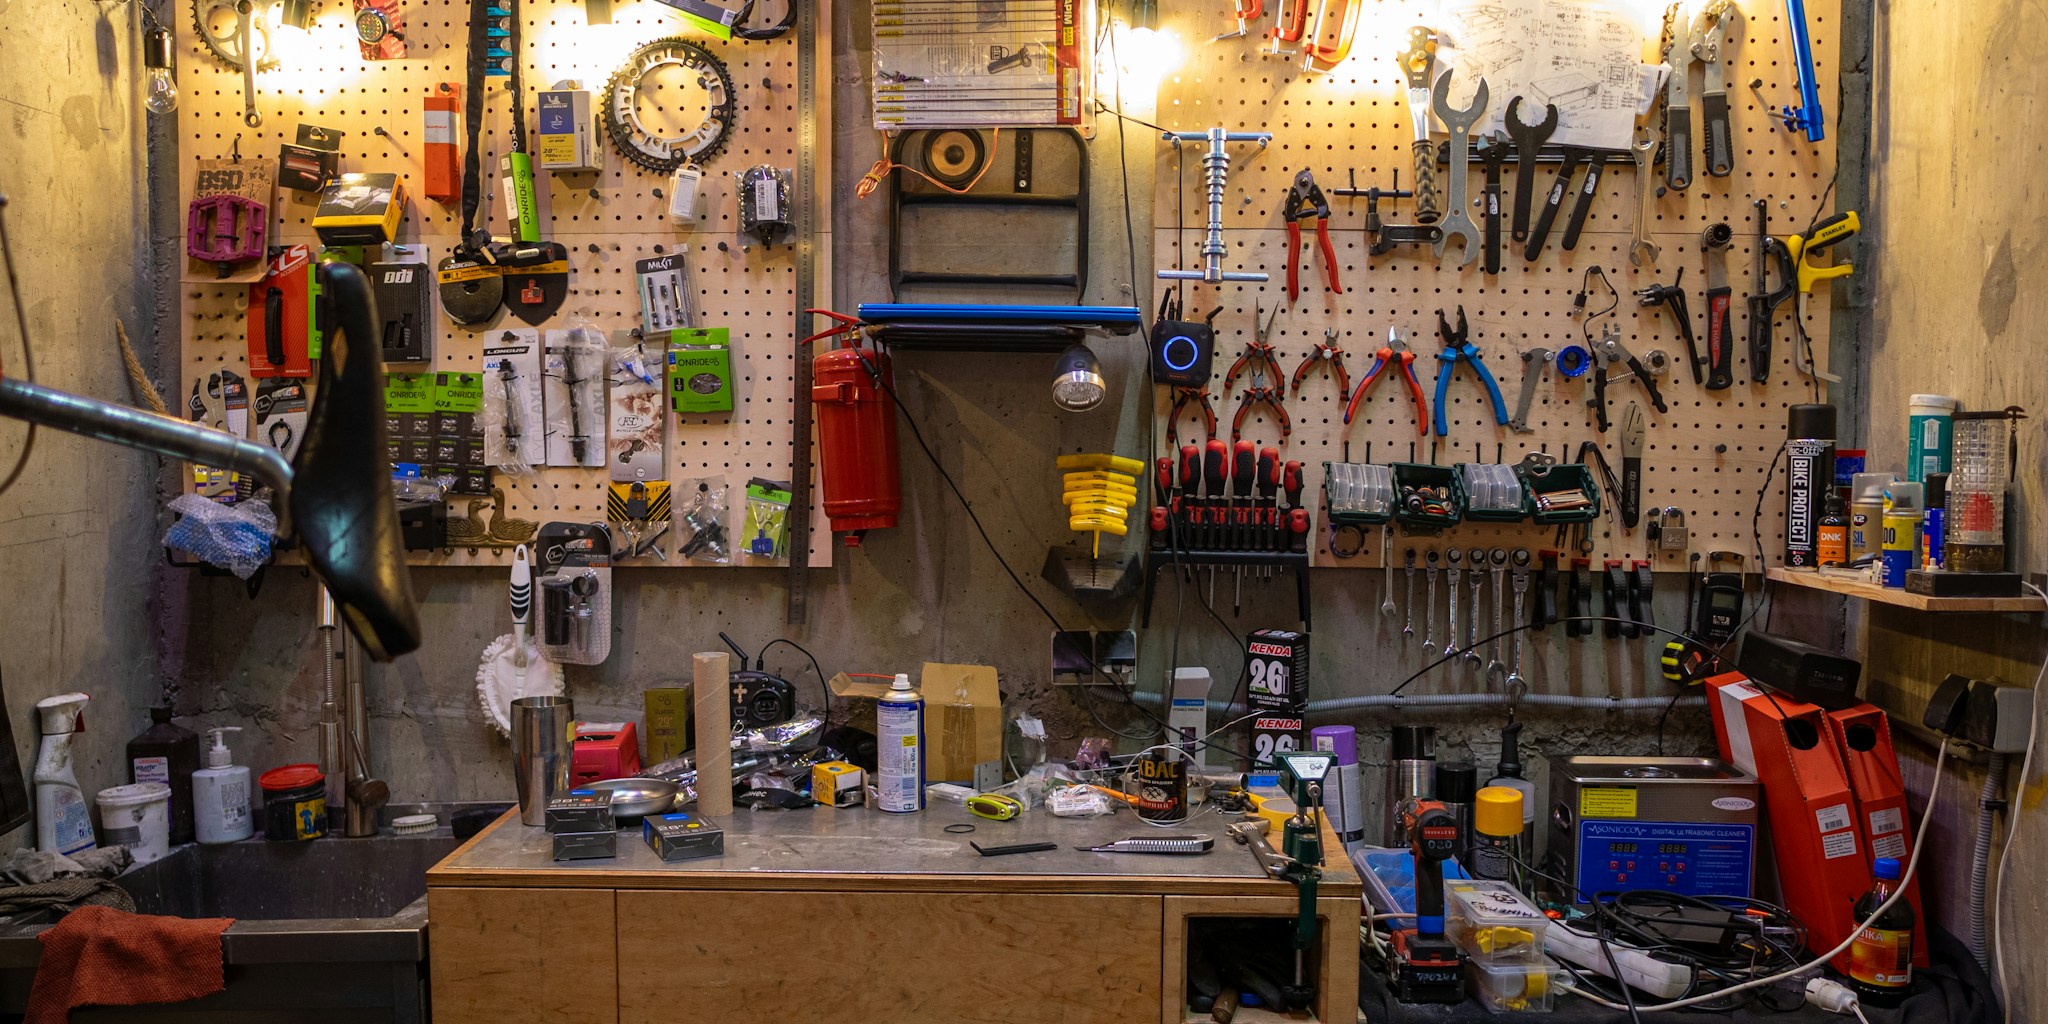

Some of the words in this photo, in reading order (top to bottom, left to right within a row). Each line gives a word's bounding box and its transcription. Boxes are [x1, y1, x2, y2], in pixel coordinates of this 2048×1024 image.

[197, 170, 243, 190] BSD
[519, 180, 530, 225] ONRIDE
[1821, 224, 1846, 237] STANLEY
[384, 267, 414, 283] odi
[678, 358, 710, 366] ONRIDE
[390, 391, 418, 399] ONRIDE
[447, 390, 476, 398] ONRIDE
[1793, 460, 1808, 487] BIKE
[1791, 489, 1807, 541] PROTECT
[1853, 514, 1865, 522] K2
[1821, 533, 1841, 541] DNK
[1249, 642, 1291, 657] KENDA
[1250, 658, 1283, 695] 26
[1255, 718, 1301, 730] KENDA
[1255, 733, 1293, 764] 26
[1597, 825, 1638, 833] SONICCO
[1677, 829, 1716, 837] ULTRASONIC
